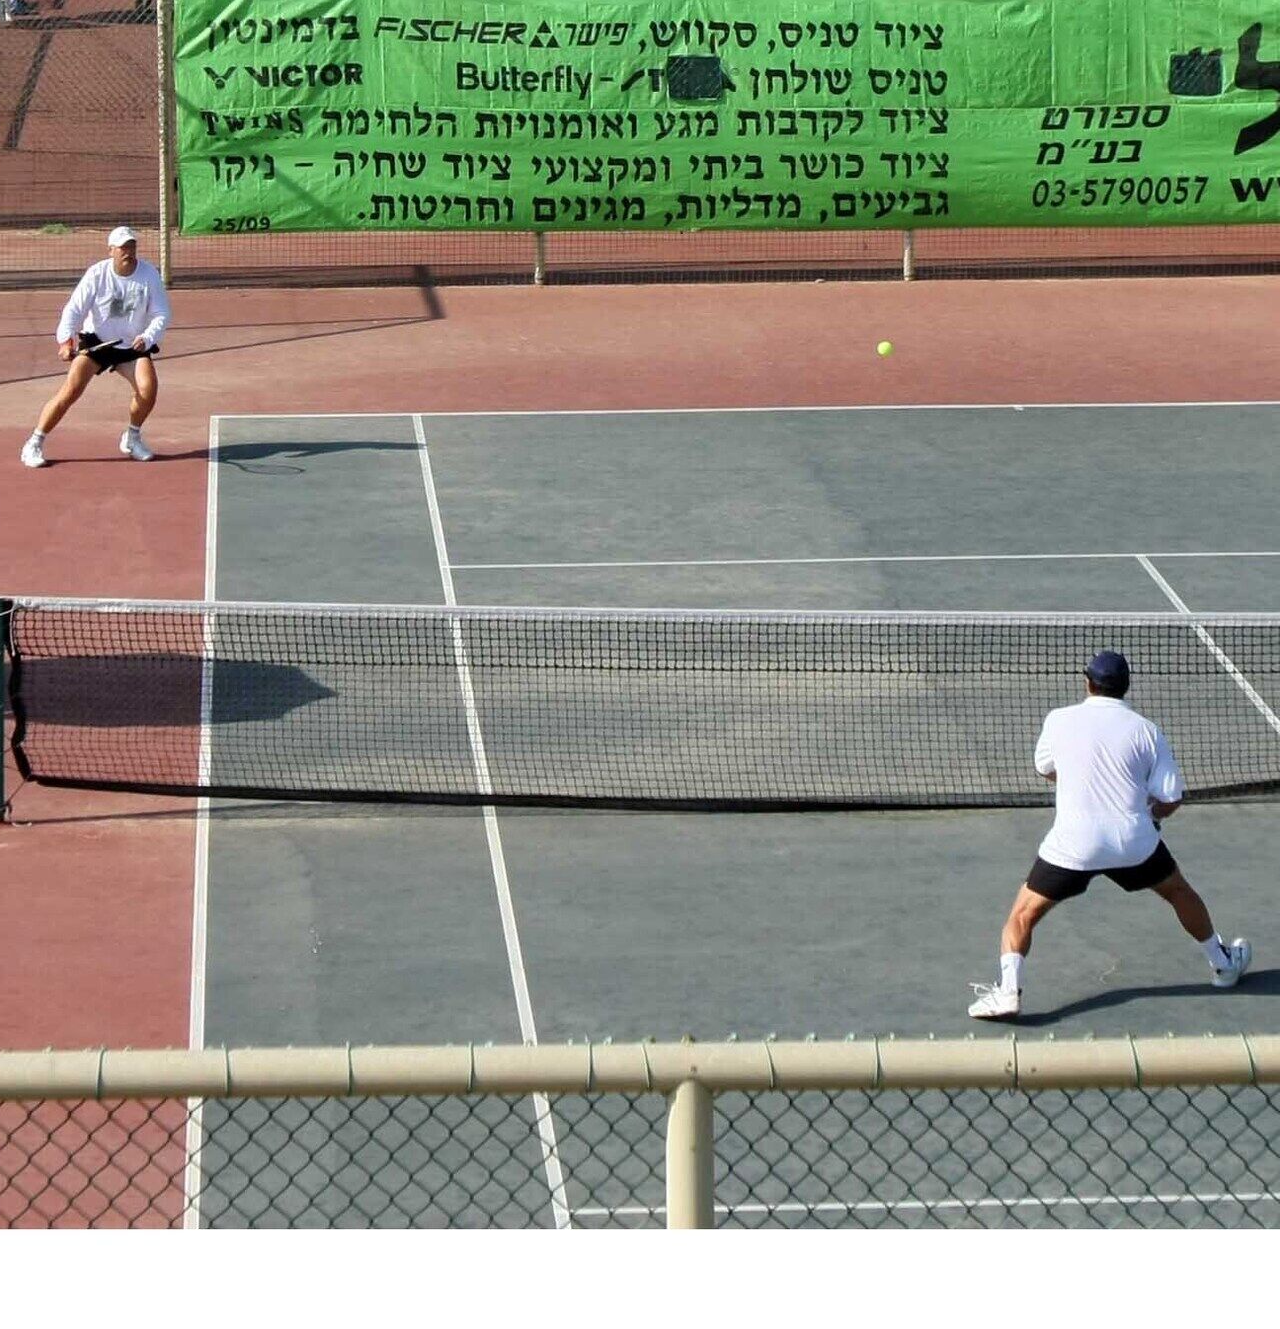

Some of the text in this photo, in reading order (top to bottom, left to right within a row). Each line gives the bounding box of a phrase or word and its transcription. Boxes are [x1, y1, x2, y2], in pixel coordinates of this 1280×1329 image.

[207, 14, 360, 52] בדמינטון
[374, 17, 528, 45] FISCHER
[638, 19, 757, 54] סקווש,
[767, 21, 860, 53] טניס,
[875, 22, 945, 50] ציוד
[245, 62, 364, 88] VICTOR
[456, 62, 593, 101] Butterfly
[749, 60, 852, 101] שולחן
[869, 67, 948, 96] טניס
[200, 101, 950, 142] ציוד לקרבות מגע ואומנויות הלחימה TWINS
[1040, 105, 1171, 131] ספורט
[333, 150, 428, 180] שחיה
[441, 152, 513, 181] ציוד
[688, 153, 764, 181] ביתי
[779, 152, 866, 181] כושר
[879, 151, 950, 179] ציוד
[1035, 139, 1142, 166] בע"מ
[209, 154, 276, 183] ניקו
[531, 156, 673, 185] ומקצועי
[1031, 175, 1209, 208] 03-5790057
[356, 189, 951, 226] גביעים, מדליות, מגינים וחריטות.
[212, 217, 272, 232] 25/09
